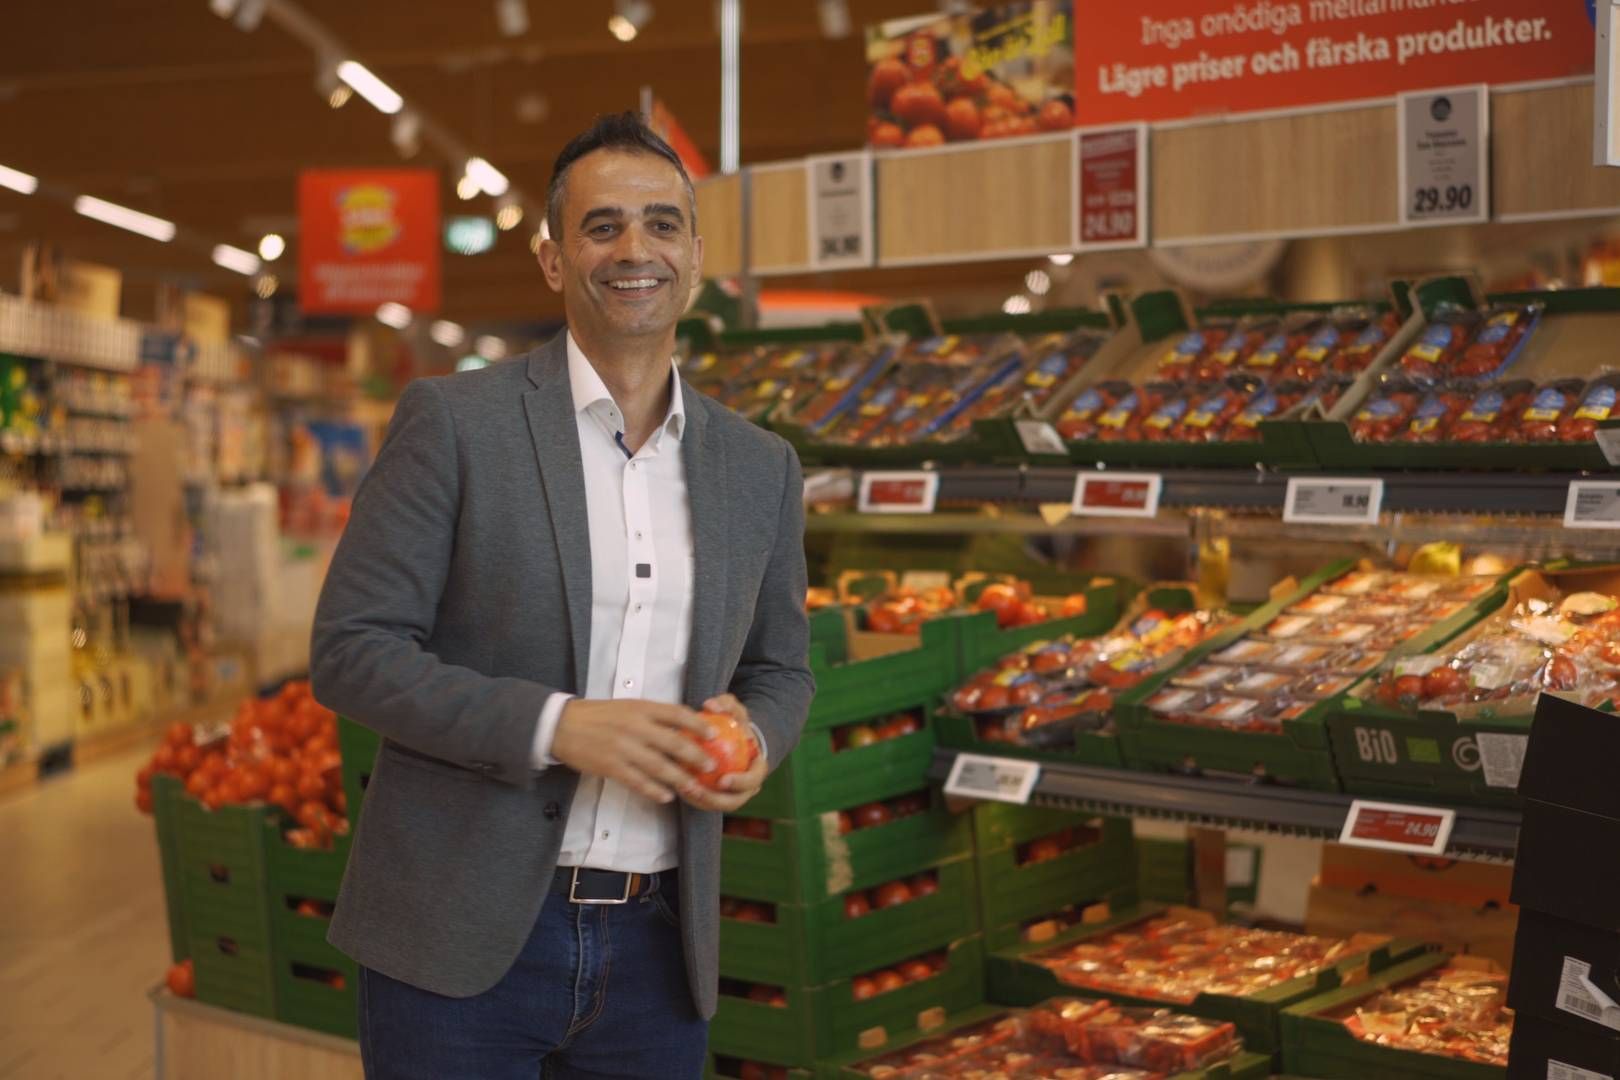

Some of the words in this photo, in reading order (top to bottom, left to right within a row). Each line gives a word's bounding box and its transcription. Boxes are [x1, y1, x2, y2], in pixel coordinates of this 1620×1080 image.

[1140, 15, 1195, 49] Inga
[1201, 1, 1302, 36] onödiga
[1098, 63, 1168, 98] Lägre
[1172, 50, 1247, 92] priser
[1251, 41, 1300, 75] och
[1306, 32, 1390, 69] färska
[1397, 16, 1553, 65] produkter.
[1414, 183, 1472, 213] 29.90
[1404, 821, 1441, 838] 24.90
